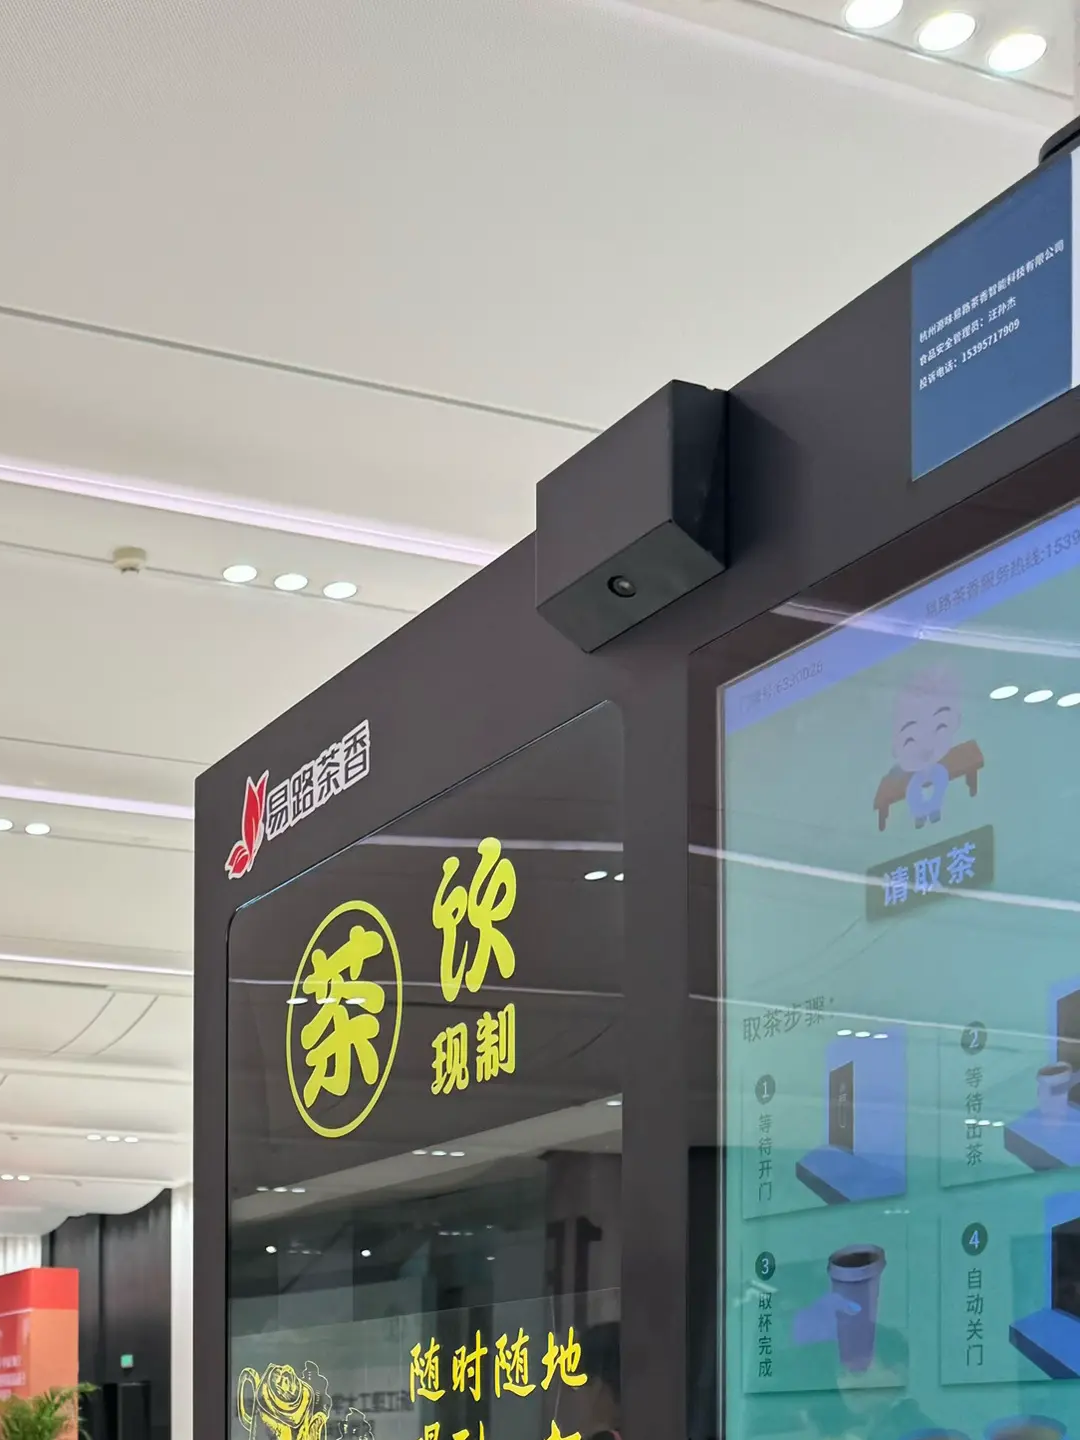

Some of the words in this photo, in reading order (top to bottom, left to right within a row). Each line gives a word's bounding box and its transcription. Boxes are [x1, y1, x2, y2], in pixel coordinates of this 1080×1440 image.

[267, 720, 370, 840] 易路茶香
[883, 841, 976, 907] 请取茶
[300, 925, 385, 1109] 茶
[431, 1002, 516, 1096] 现制
[758, 1113, 773, 1202] 等待开门
[965, 1065, 983, 1167] 等待出茶
[758, 1292, 773, 1378] 取杯完成
[966, 1267, 984, 1367] 自动关门
[409, 1326, 588, 1403] 随时随地
